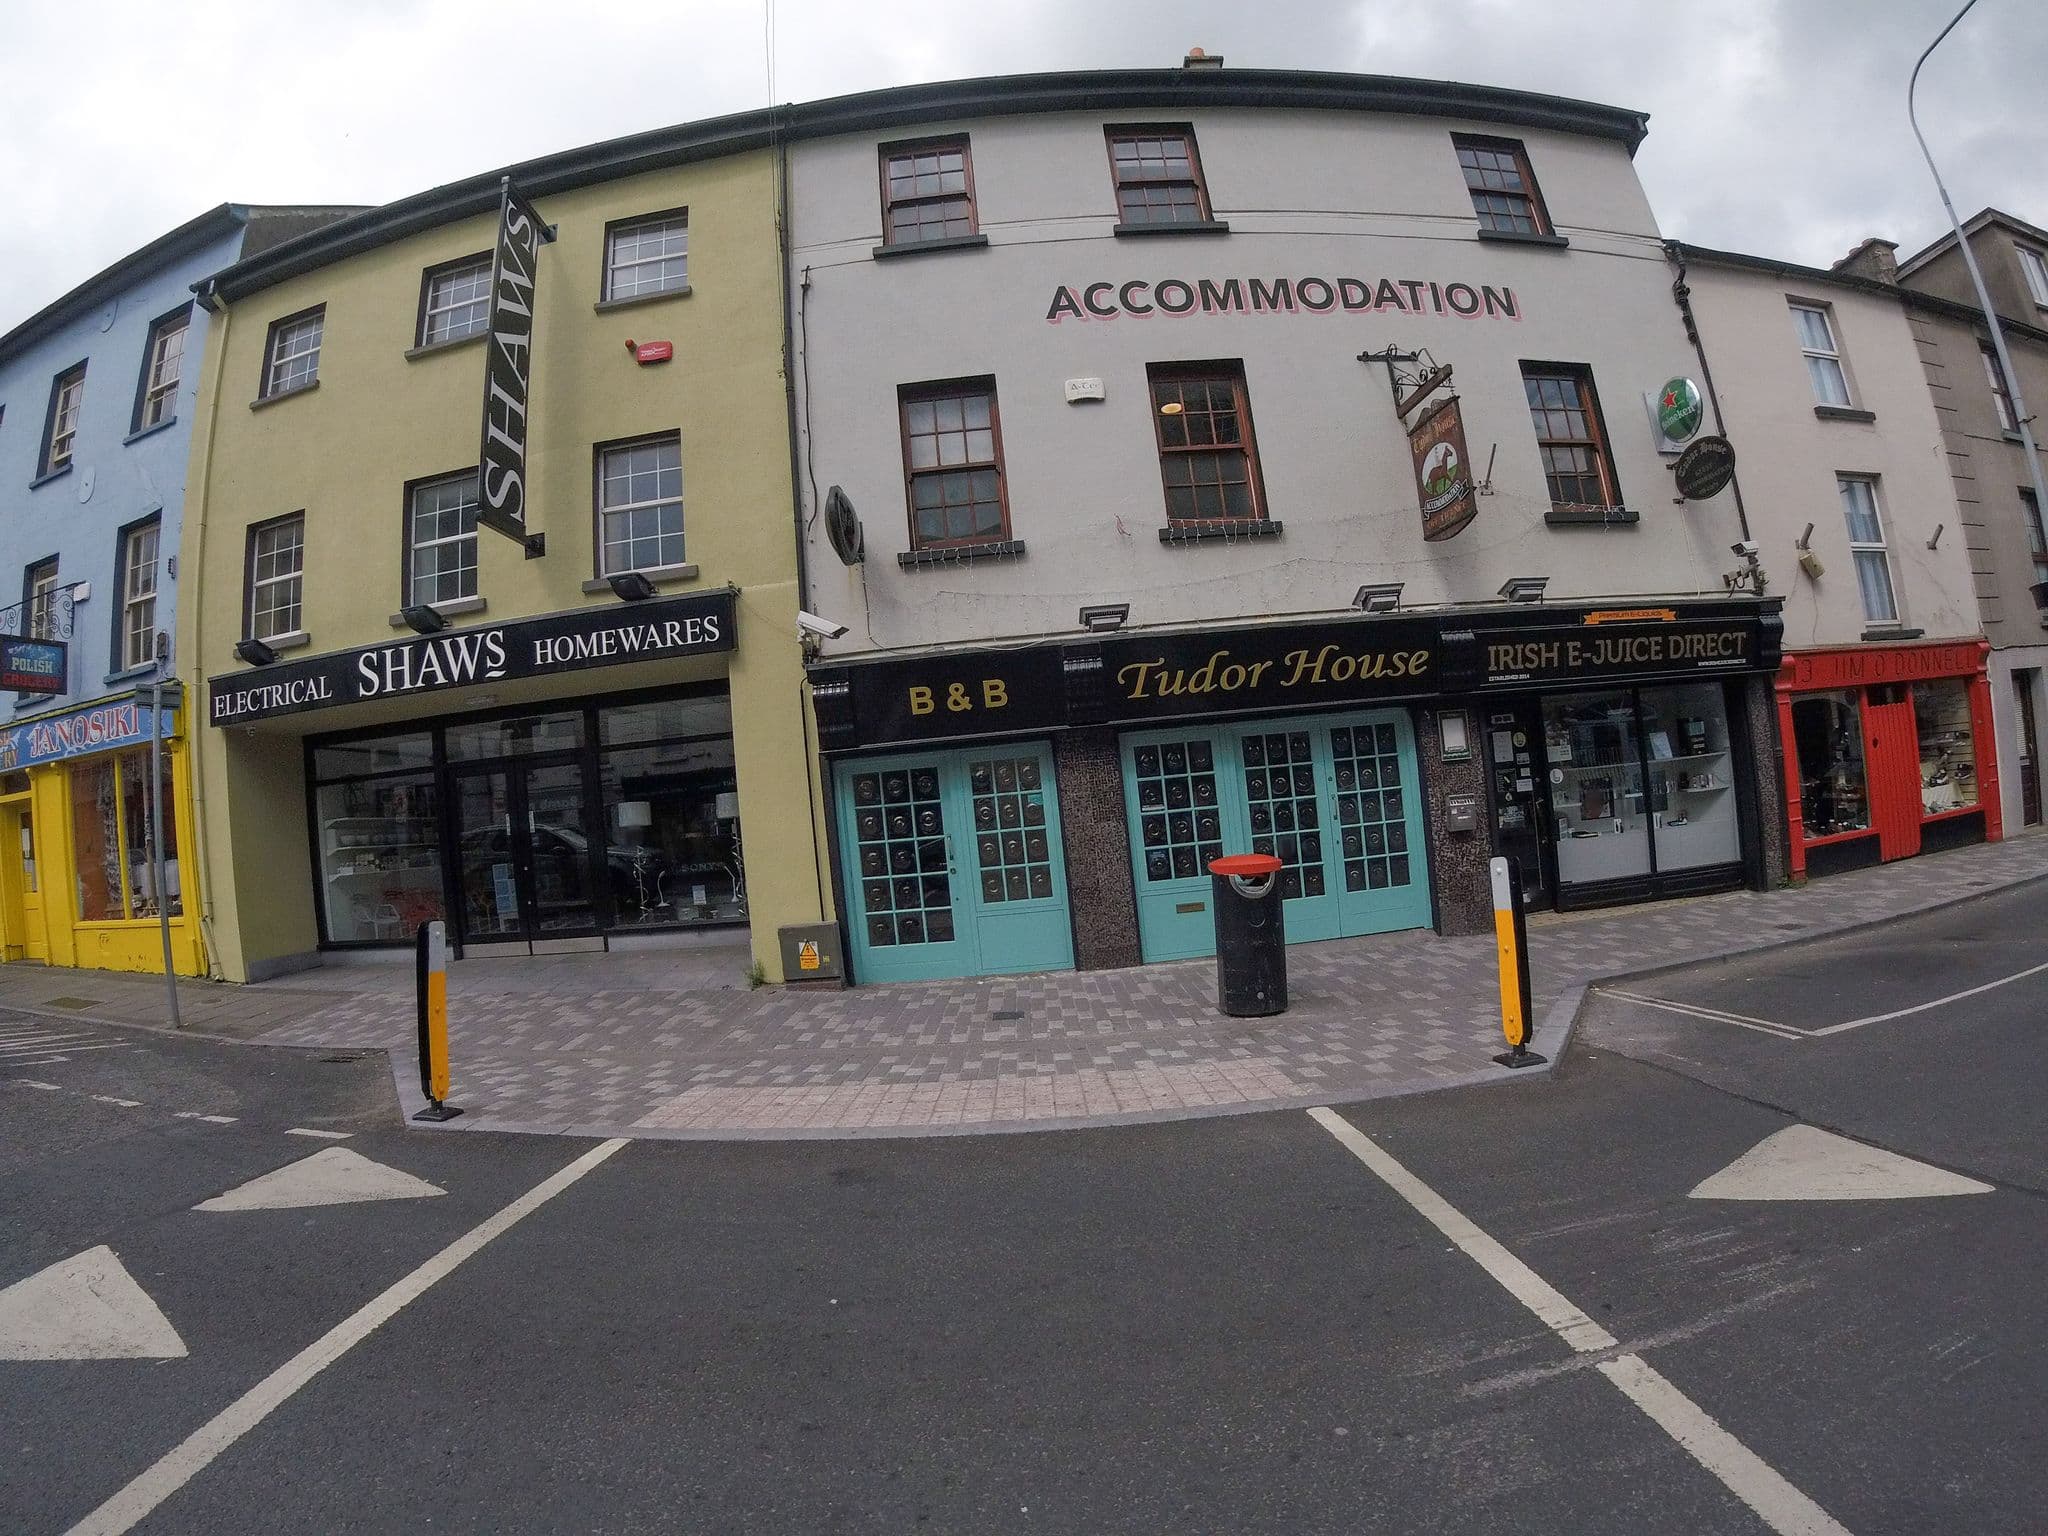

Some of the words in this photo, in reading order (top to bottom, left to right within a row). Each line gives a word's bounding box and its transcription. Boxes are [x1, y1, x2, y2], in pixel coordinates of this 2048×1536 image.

[1046, 276, 1522, 325] ACCOMMODATION
[485, 199, 537, 523] SHAWS
[11, 656, 53, 674] POLISH
[214, 676, 333, 718] ELECTRICAL
[358, 630, 507, 697] SHAWS
[533, 615, 721, 664] HOMEWARES
[1117, 651, 1273, 701] Tudor
[1281, 644, 1430, 688] House
[1487, 642, 1561, 673] IRISH
[1566, 634, 1665, 668] E-JUICE
[1668, 631, 1748, 660] DIRECT
[909, 686, 935, 716] B
[946, 682, 974, 712] &
[982, 678, 1010, 709] B
[31, 704, 140, 757] JANOSIKI
